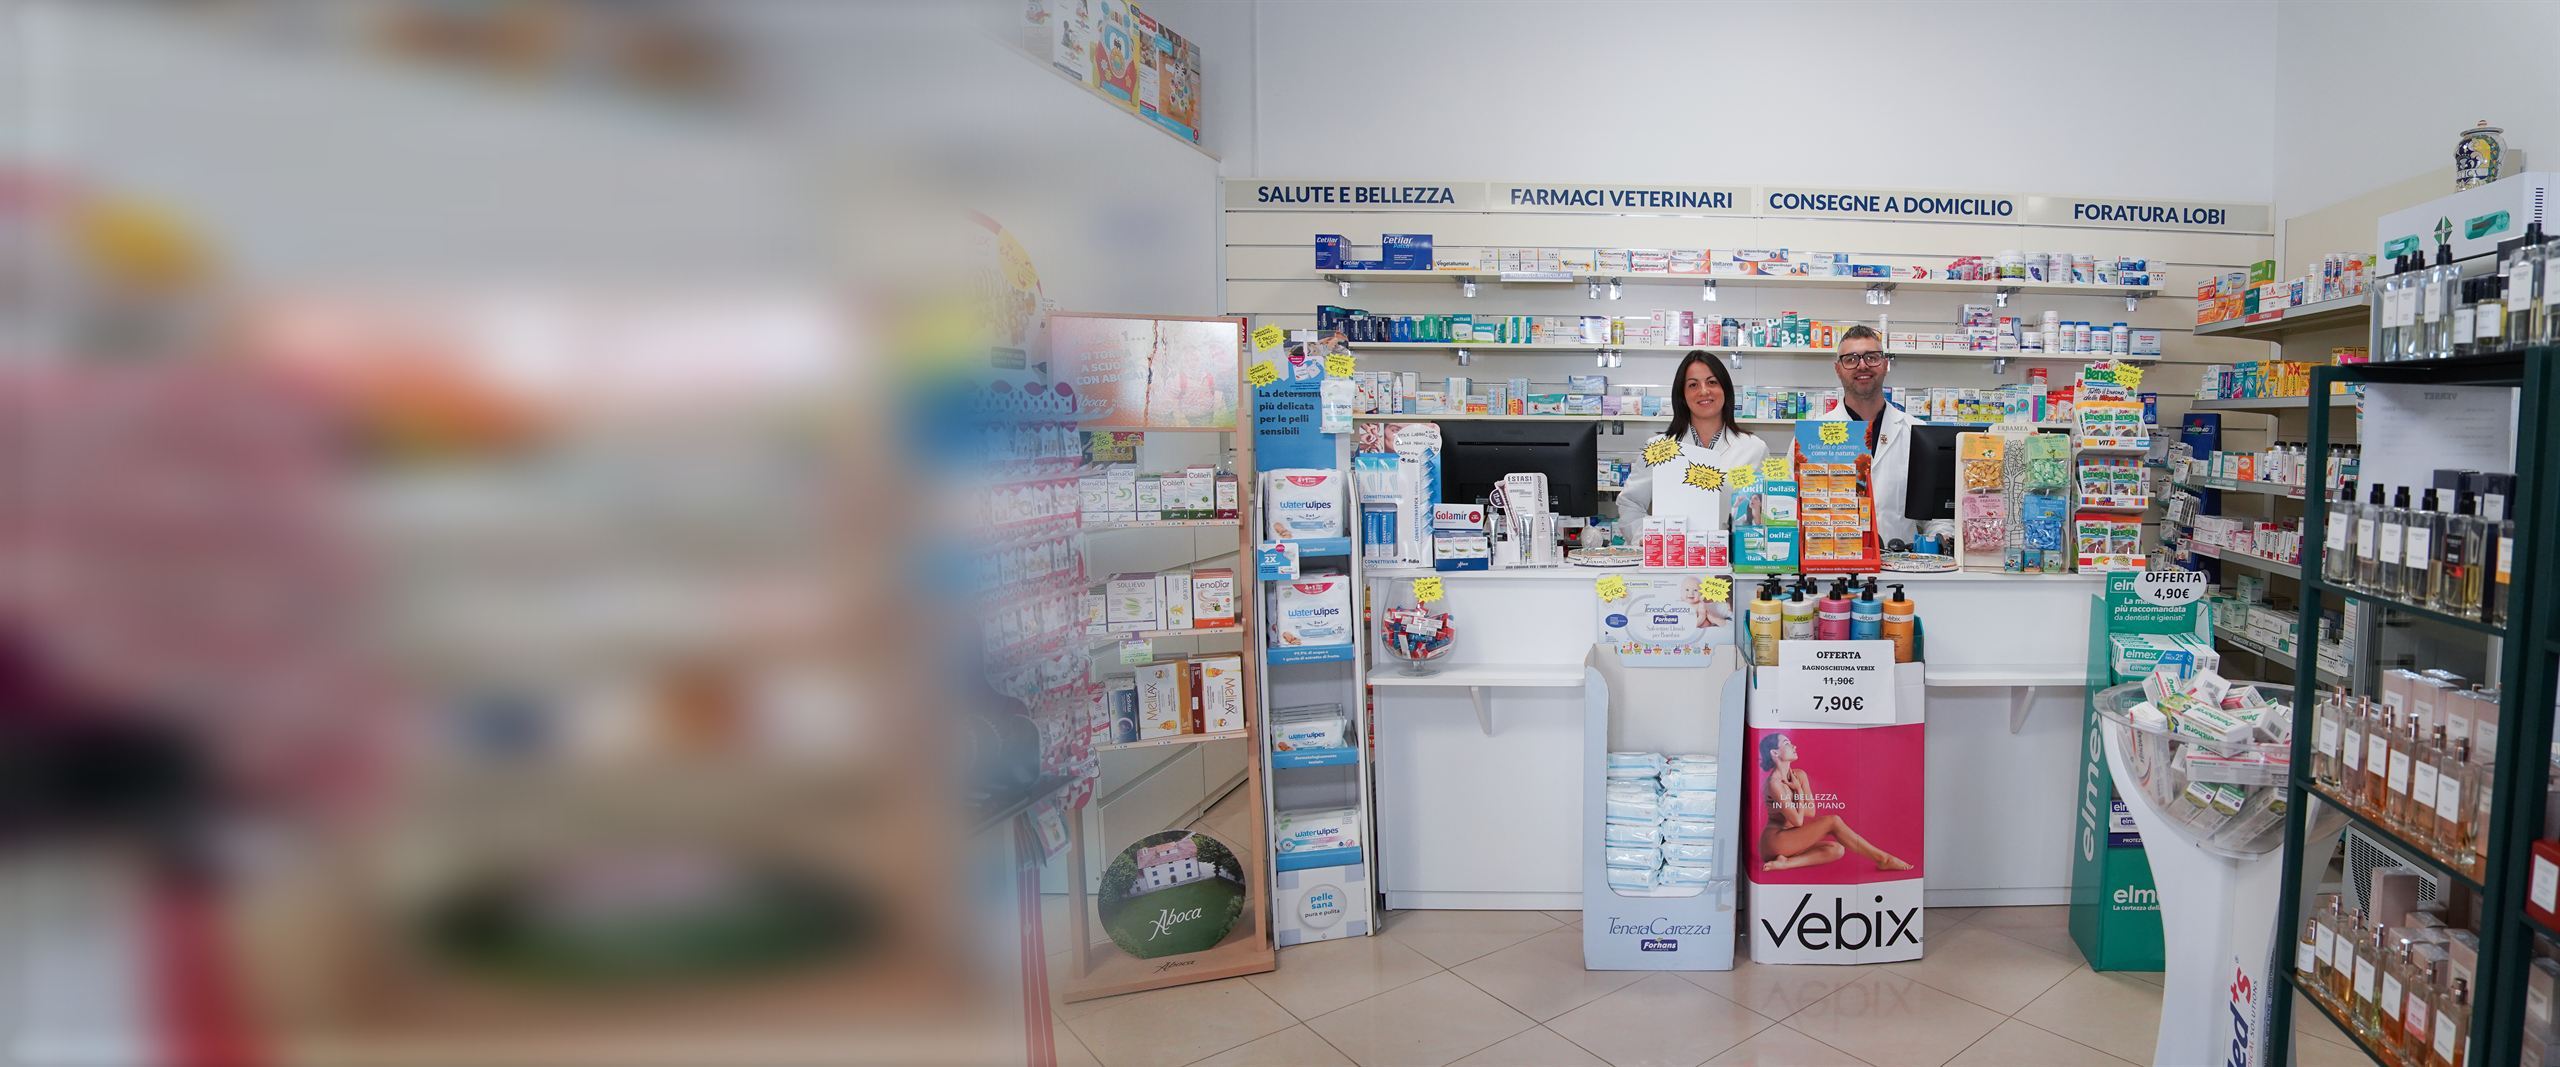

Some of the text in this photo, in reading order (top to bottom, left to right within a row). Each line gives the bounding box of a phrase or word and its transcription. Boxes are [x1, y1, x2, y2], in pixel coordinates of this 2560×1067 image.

[1258, 186, 1455, 204] SALUTE E BELLEZZA
[1511, 188, 1732, 209] FARMACI VETERINARI
[1769, 193, 2013, 216] CONSEGNE A DOMICILIO
[2074, 204, 2225, 225] FORATURA LOBI
[1316, 236, 1338, 244] Cetilar
[1383, 236, 1413, 245] Cetilar
[2084, 367, 2116, 384] Beneg
[1259, 390, 1271, 398] La
[1259, 402, 1275, 412] più
[1277, 402, 1314, 411] delicata
[1260, 415, 1309, 425] per le pelli
[1260, 428, 1300, 436] sensibili
[2145, 572, 2201, 583] OFFERTA
[2114, 579, 2134, 591] elm
[2154, 588, 2190, 600] 4,90€
[2124, 597, 2134, 605] La
[2115, 605, 2187, 614] più raccomandata
[1816, 651, 1862, 660] OFFERTA
[2125, 650, 2157, 659] elmex
[1823, 677, 1855, 686] 11,90€
[1813, 696, 1864, 712] 7,90€
[1817, 802, 1846, 810] PIANO
[1310, 892, 1333, 904] pelle
[2113, 885, 2158, 904] elm
[1311, 901, 1333, 910] sana
[1304, 911, 1318, 919] pura
[1324, 908, 1341, 916] pulita
[1148, 907, 1202, 942] Aboca
[1643, 941, 1676, 949] Forhans
